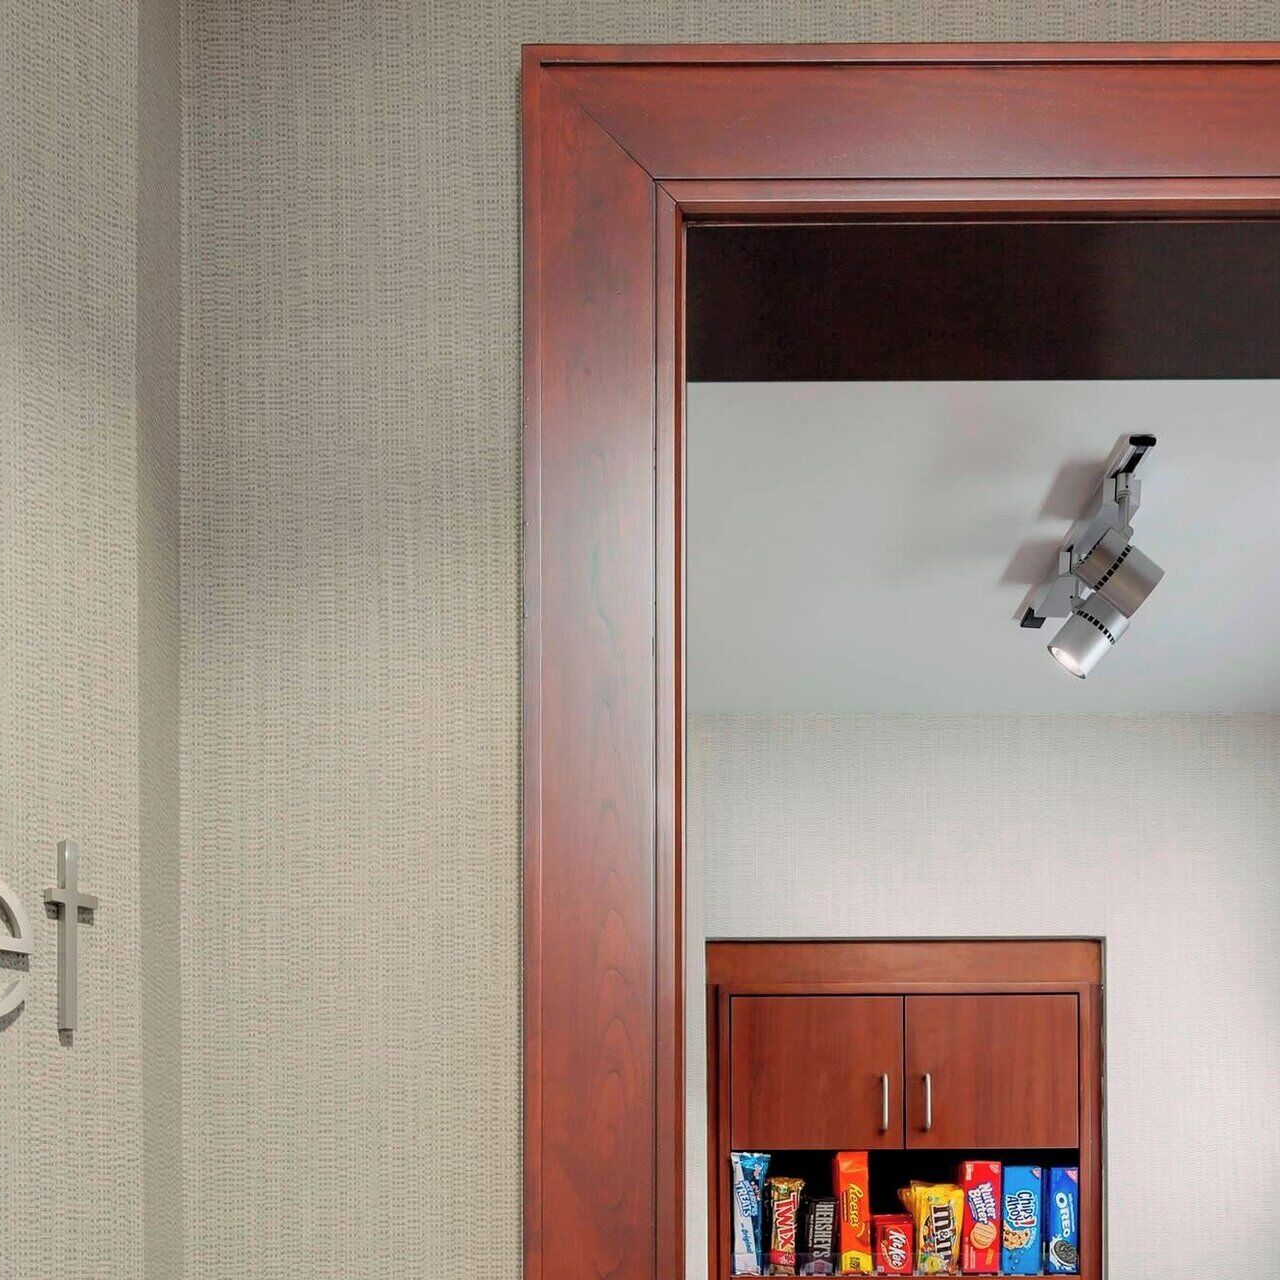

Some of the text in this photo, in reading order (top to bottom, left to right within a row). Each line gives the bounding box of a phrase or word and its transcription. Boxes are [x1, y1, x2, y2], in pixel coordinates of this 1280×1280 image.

[735, 1182, 752, 1217] TREATS
[968, 1190, 989, 1224] Butter
[979, 1182, 997, 1219] Nutter
[1017, 1191, 1034, 1221] Chips
[1055, 1192, 1071, 1238] OREO
[774, 1192, 798, 1250] TWIX
[813, 1203, 834, 1258] HERSHEY'S
